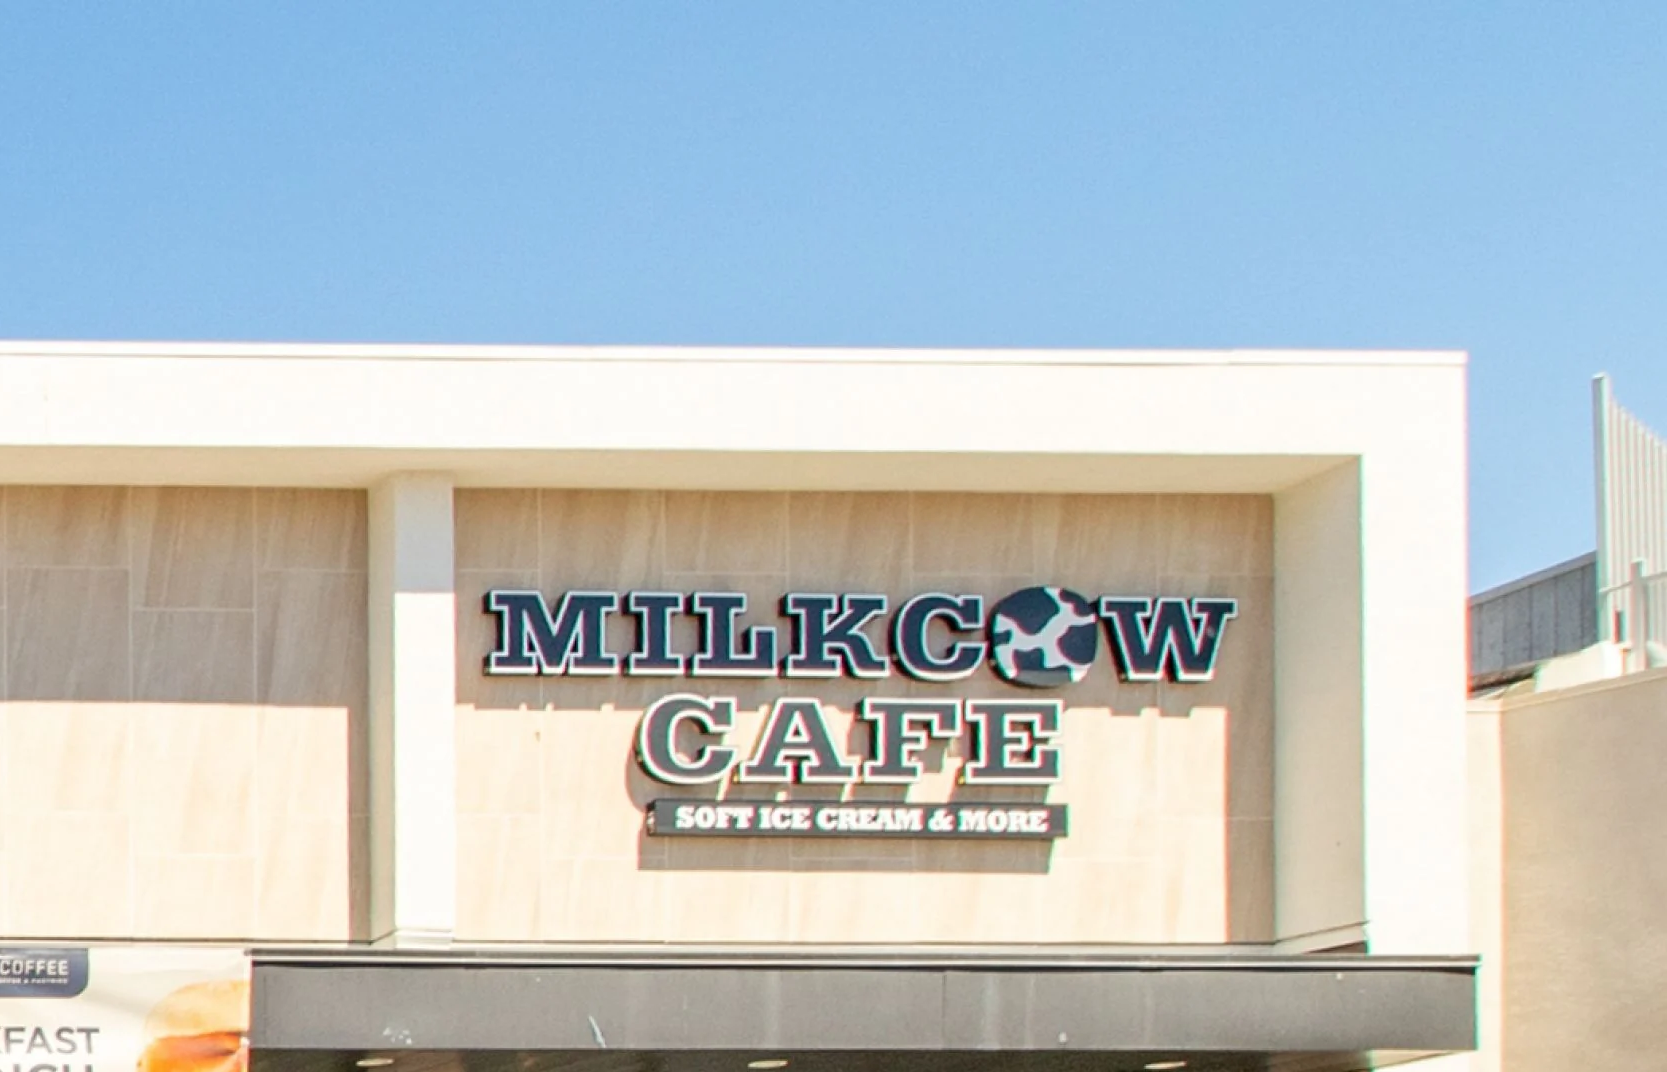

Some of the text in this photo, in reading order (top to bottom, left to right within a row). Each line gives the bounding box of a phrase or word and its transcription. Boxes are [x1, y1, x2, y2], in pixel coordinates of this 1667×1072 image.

[484, 586, 1237, 687] MILKCOW
[638, 694, 1064, 784] CAFE
[675, 805, 1050, 833] SOFT ICE CREAM & MORE
[0, 959, 68, 975] COFFEE
